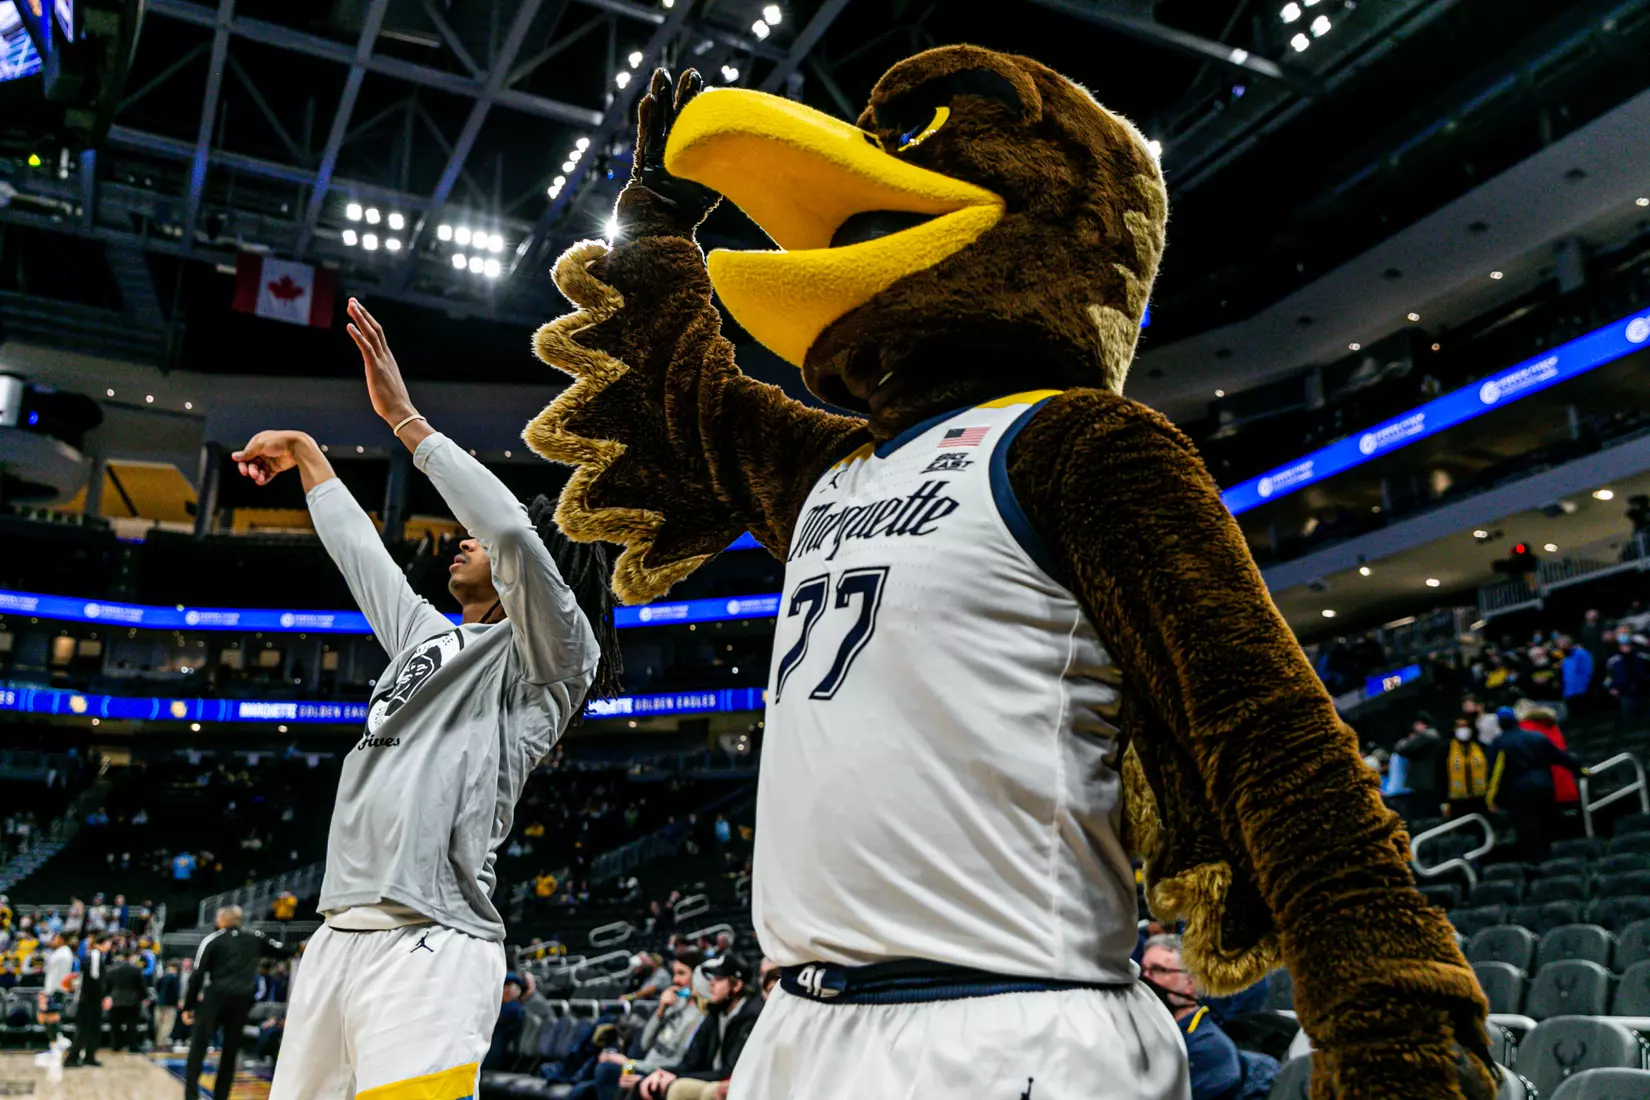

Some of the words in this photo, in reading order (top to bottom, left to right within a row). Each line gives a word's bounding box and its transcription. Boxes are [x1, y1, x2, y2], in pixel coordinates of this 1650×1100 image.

[926, 461, 974, 470] EAST
[934, 452, 969, 462] BIG
[786, 480, 960, 561] Marquette
[775, 566, 890, 705] 77
